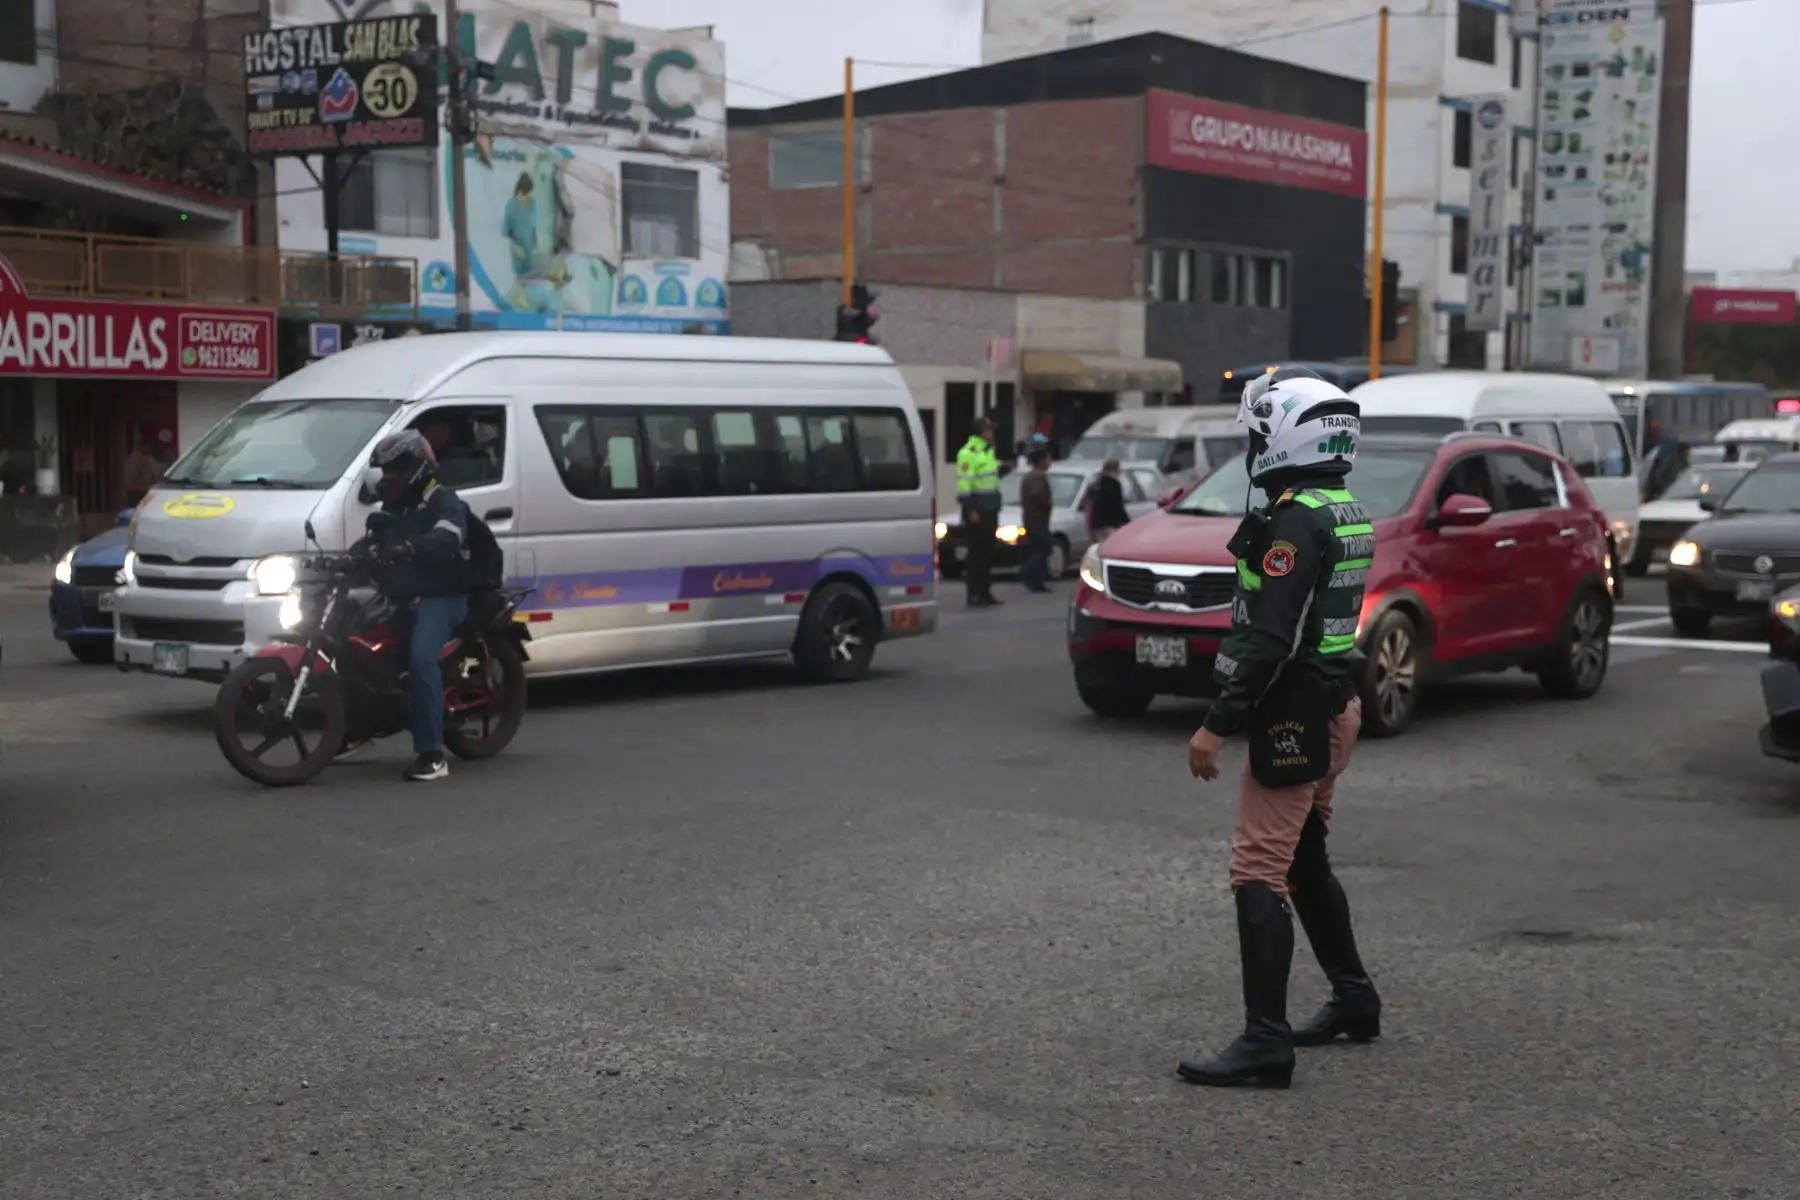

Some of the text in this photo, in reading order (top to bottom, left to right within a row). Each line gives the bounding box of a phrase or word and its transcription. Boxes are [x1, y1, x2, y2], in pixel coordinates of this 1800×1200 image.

[245, 18, 421, 72] HOSTAL SAN BLAS
[374, 76, 406, 111] 30
[1190, 114, 1253, 150] GRUPO
[1253, 126, 1353, 169] NAKASHIMA
[0, 309, 169, 370] ARRILLAS
[189, 320, 260, 345] DELIVERY
